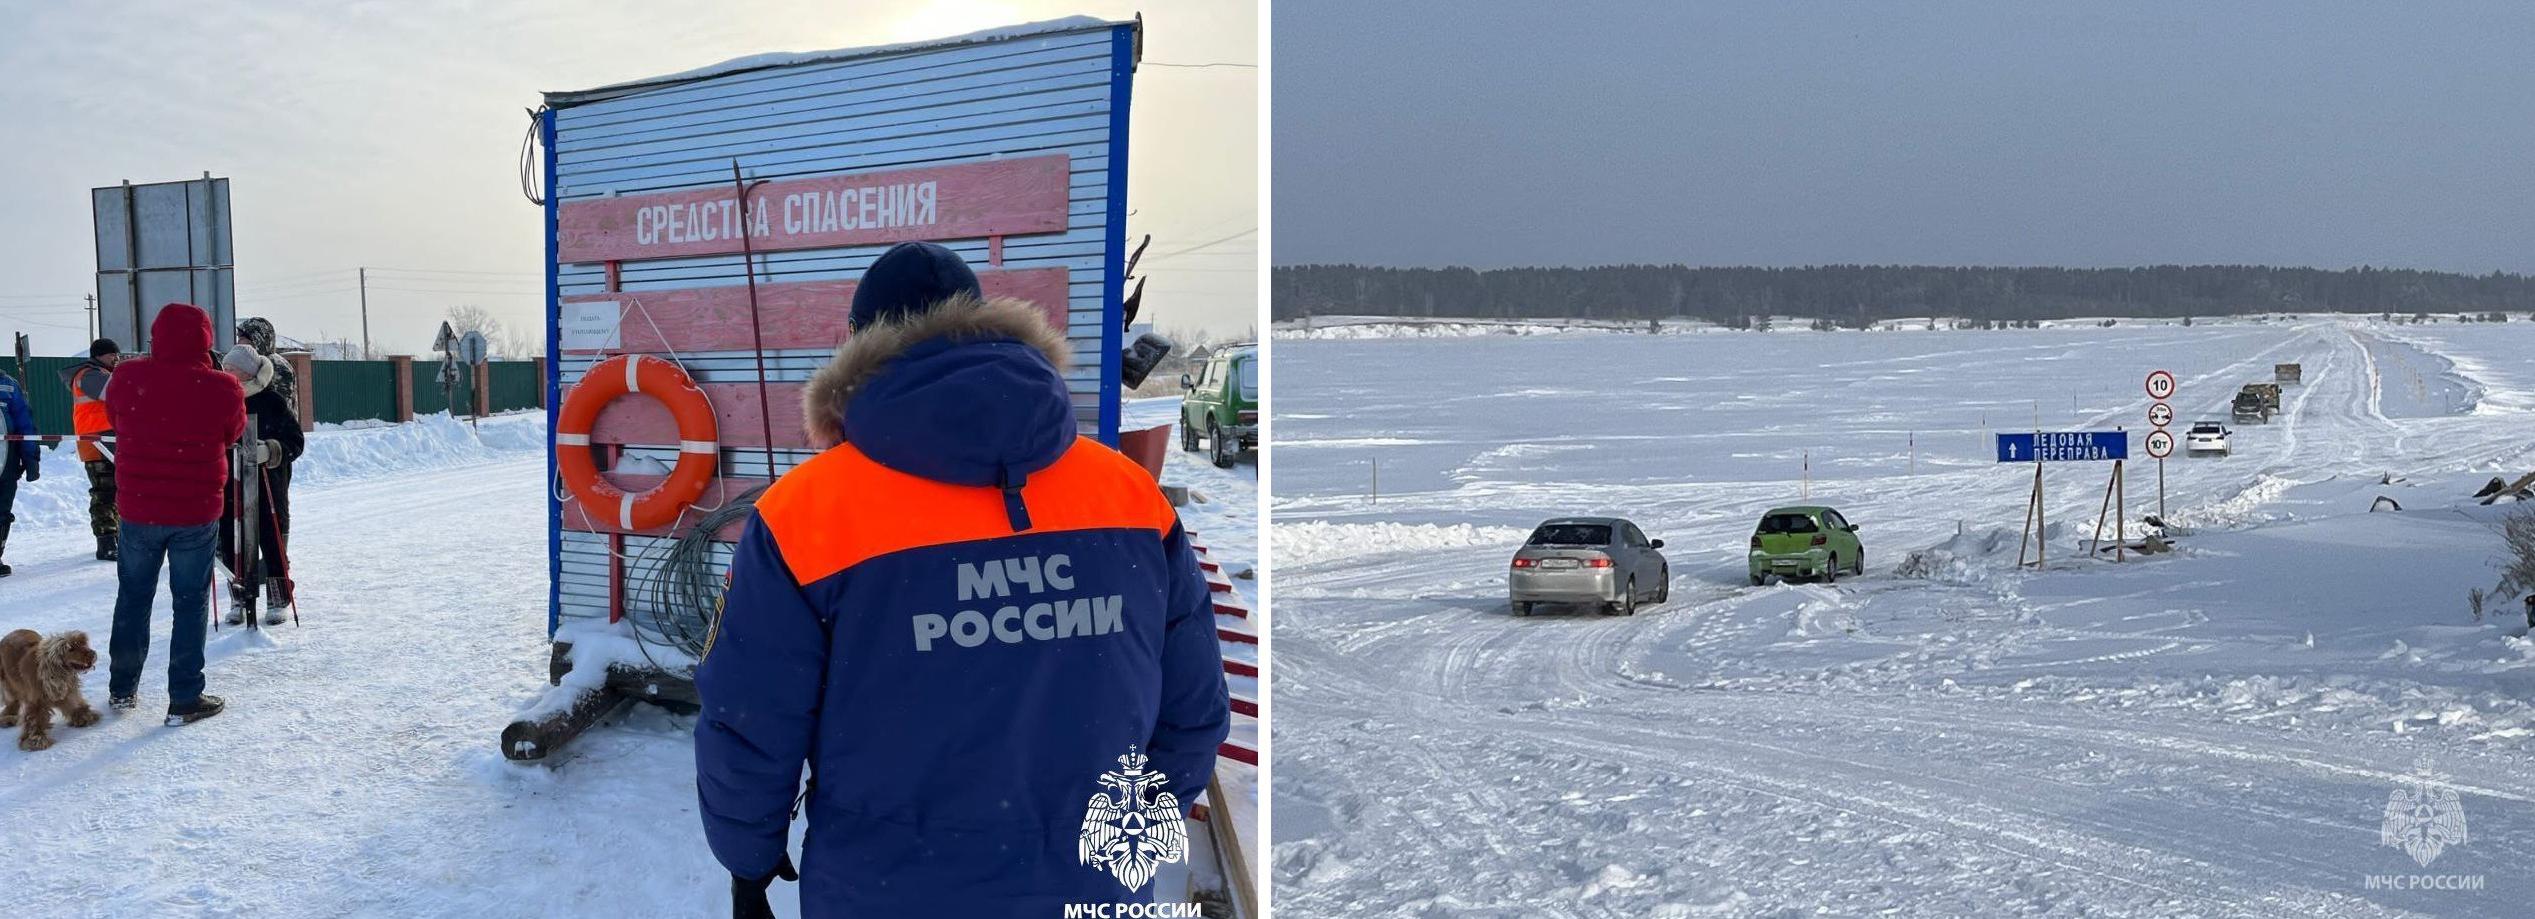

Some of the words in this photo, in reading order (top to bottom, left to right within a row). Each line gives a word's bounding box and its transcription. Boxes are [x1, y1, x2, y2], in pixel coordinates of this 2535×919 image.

[636, 196, 770, 246] СРЕДСТВА
[783, 180, 937, 236] СПАСЕНИЯ
[2153, 379, 2168, 391] 10
[2033, 433, 2093, 447] ЛЕДОВАЯ
[2033, 446, 2108, 461] ПЕРЕПРАВА
[957, 554, 1075, 601] МЧС
[912, 595, 1124, 651] РОССИИ
